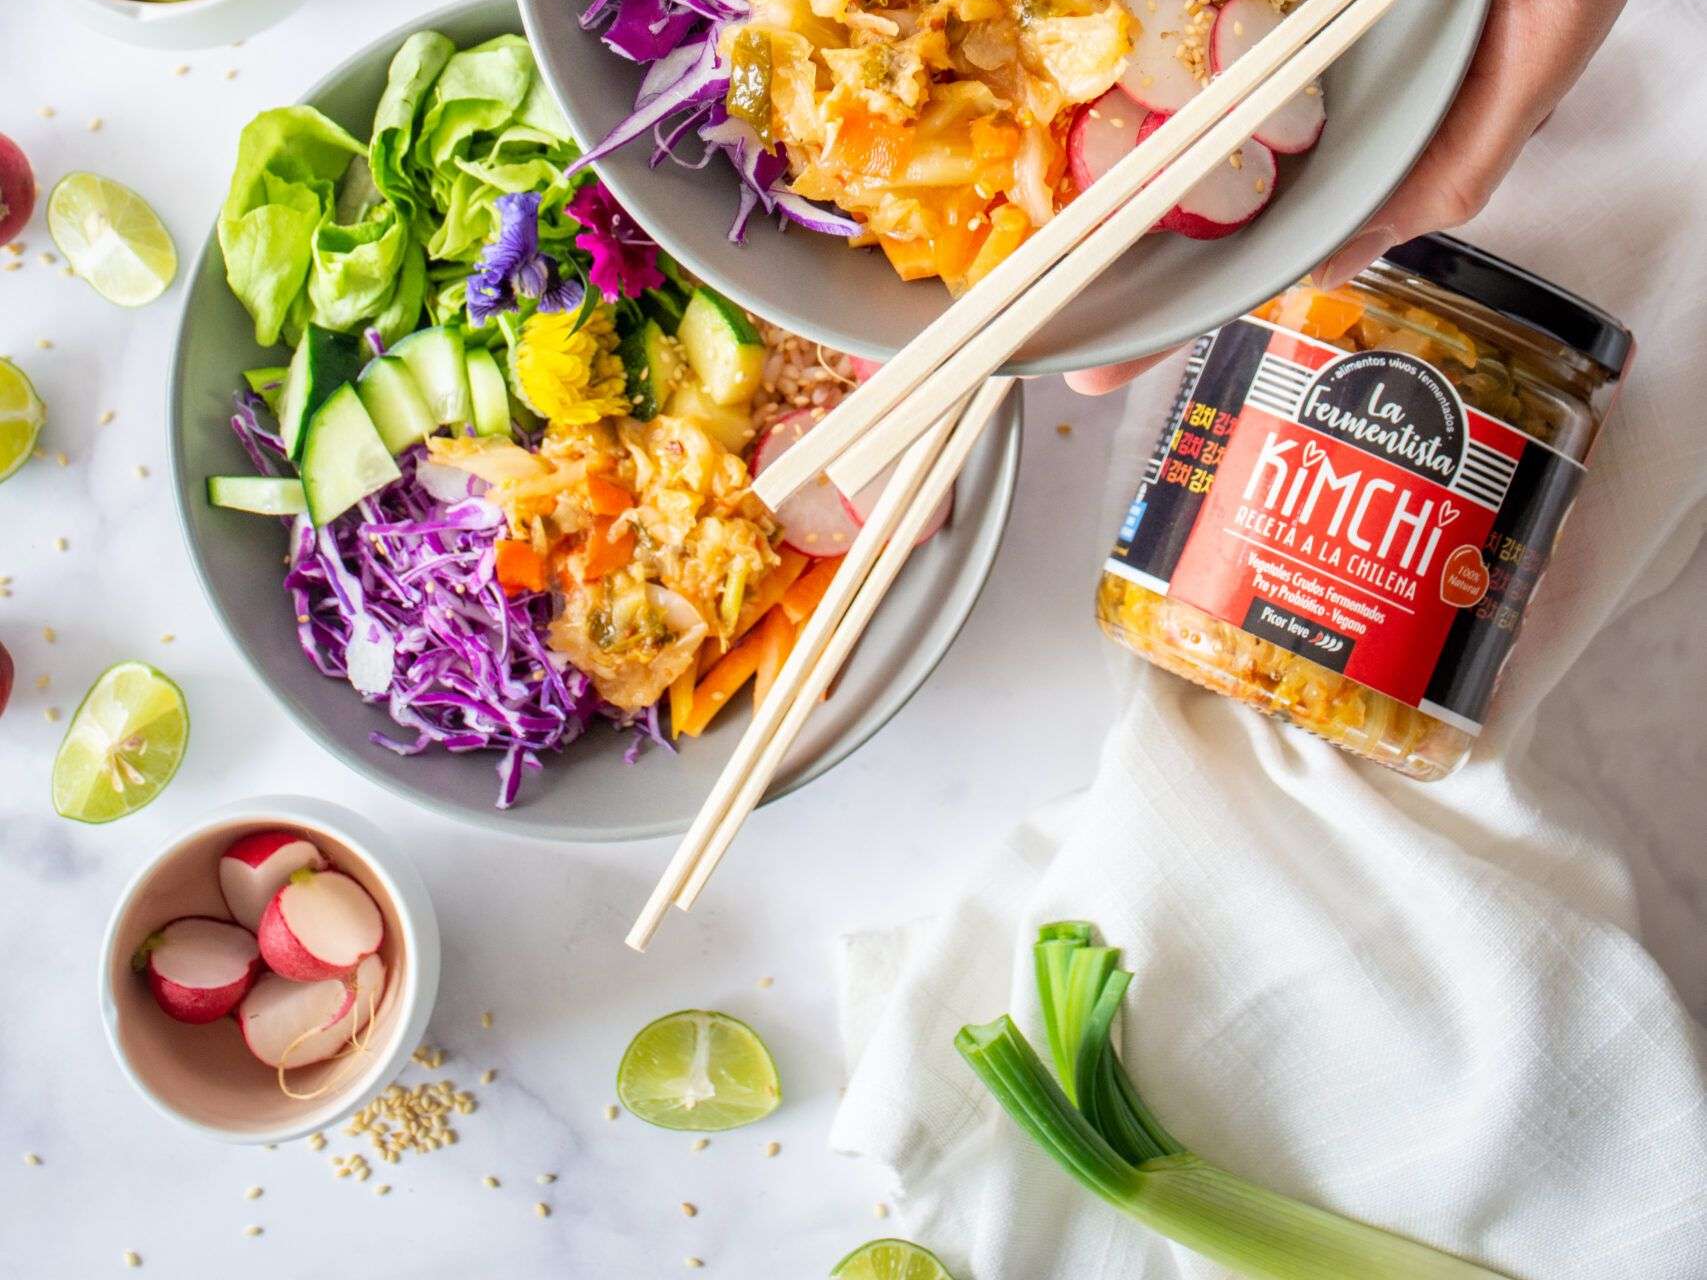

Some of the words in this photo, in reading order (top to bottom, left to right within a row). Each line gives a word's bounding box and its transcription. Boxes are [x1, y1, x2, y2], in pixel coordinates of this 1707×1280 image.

[1335, 356, 1386, 379] alimentos
[1389, 357, 1417, 376] vivos
[1418, 370, 1455, 433] fermentados
[1368, 382, 1406, 424] La
[1303, 384, 1455, 476] Fermentista
[1234, 505, 1297, 547] RECETA
[1300, 534, 1315, 555] A
[1318, 541, 1342, 567] LA
[1346, 554, 1418, 601] CHILENA
[1448, 574, 1481, 596] Natural
[1247, 551, 1292, 583] Vegetales
[1292, 572, 1326, 597] Crudos
[1325, 585, 1386, 624] Fermentados
[1252, 573, 1270, 592] Pre
[1268, 584, 1279, 598] y
[1331, 607, 1367, 635] Vegano
[1259, 606, 1289, 630] Picor
[1287, 616, 1311, 639] leve
